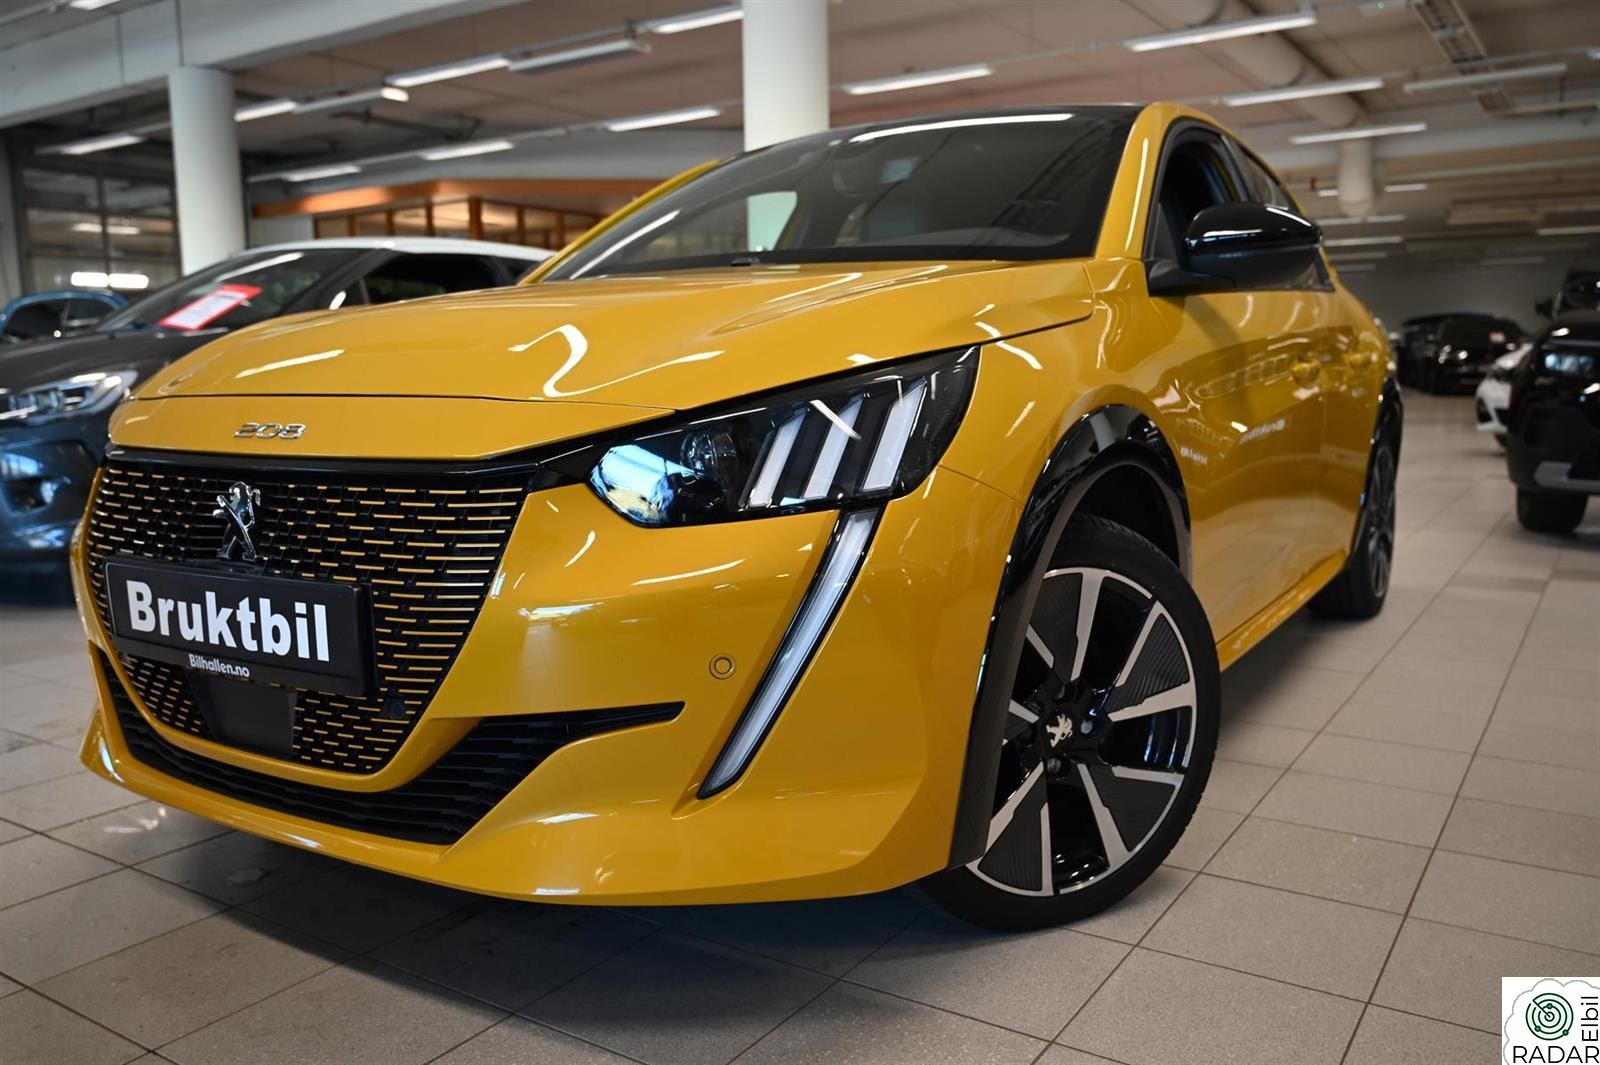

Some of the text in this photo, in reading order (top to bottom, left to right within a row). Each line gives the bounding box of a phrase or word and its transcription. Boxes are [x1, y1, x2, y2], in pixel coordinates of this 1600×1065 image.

[234, 422, 306, 439] 208
[126, 580, 330, 662] Bruktbil
[188, 653, 250, 678] Bilhallen.no
